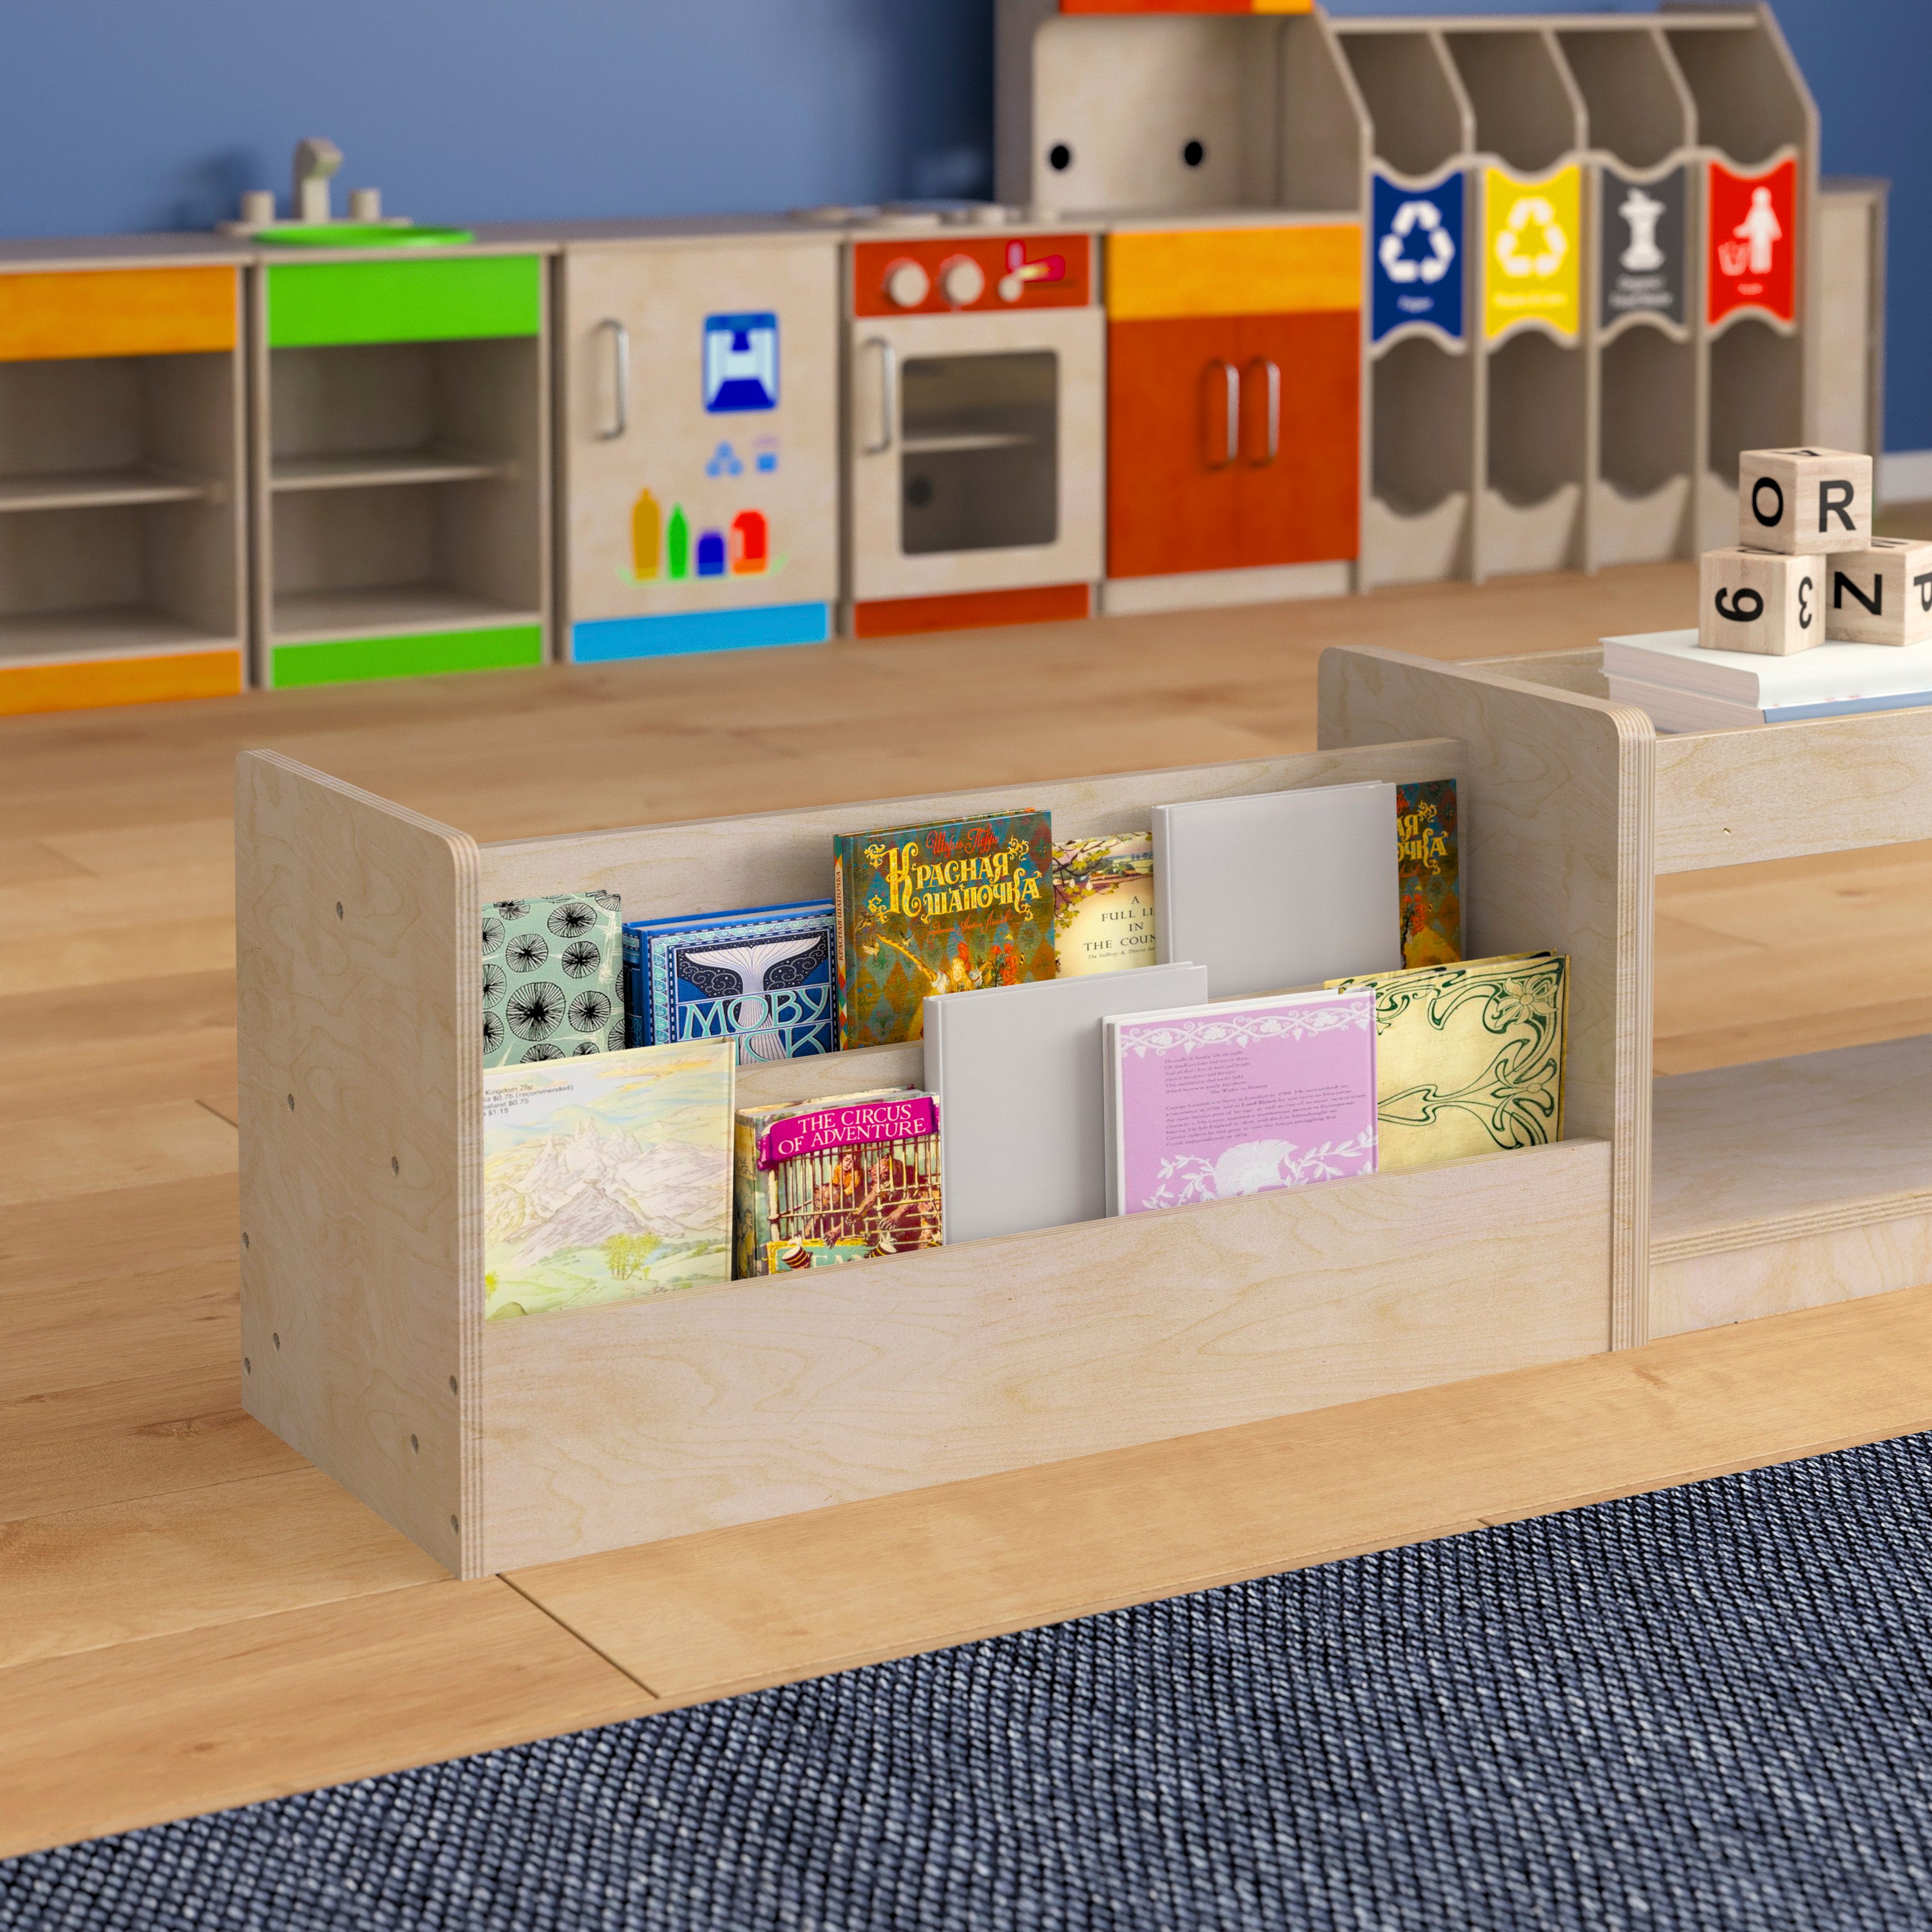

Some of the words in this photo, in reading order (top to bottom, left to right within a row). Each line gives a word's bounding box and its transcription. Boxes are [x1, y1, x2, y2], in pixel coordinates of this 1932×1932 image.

[1818, 480, 1857, 533] R
[1132, 896, 1140, 904] A
[1102, 910, 1135, 922] FULL
[1129, 922, 1144, 932] IN
[1083, 940, 1113, 952] THE
[680, 985, 829, 1040] MOBY
[734, 1023, 827, 1066] ICK
[486, 1086, 518, 1096] Kingdom
[798, 1113, 836, 1135] THE
[841, 1104, 912, 1127] CIRCUS
[778, 1136, 804, 1155] OF
[811, 1117, 927, 1148] ADVENTURE
